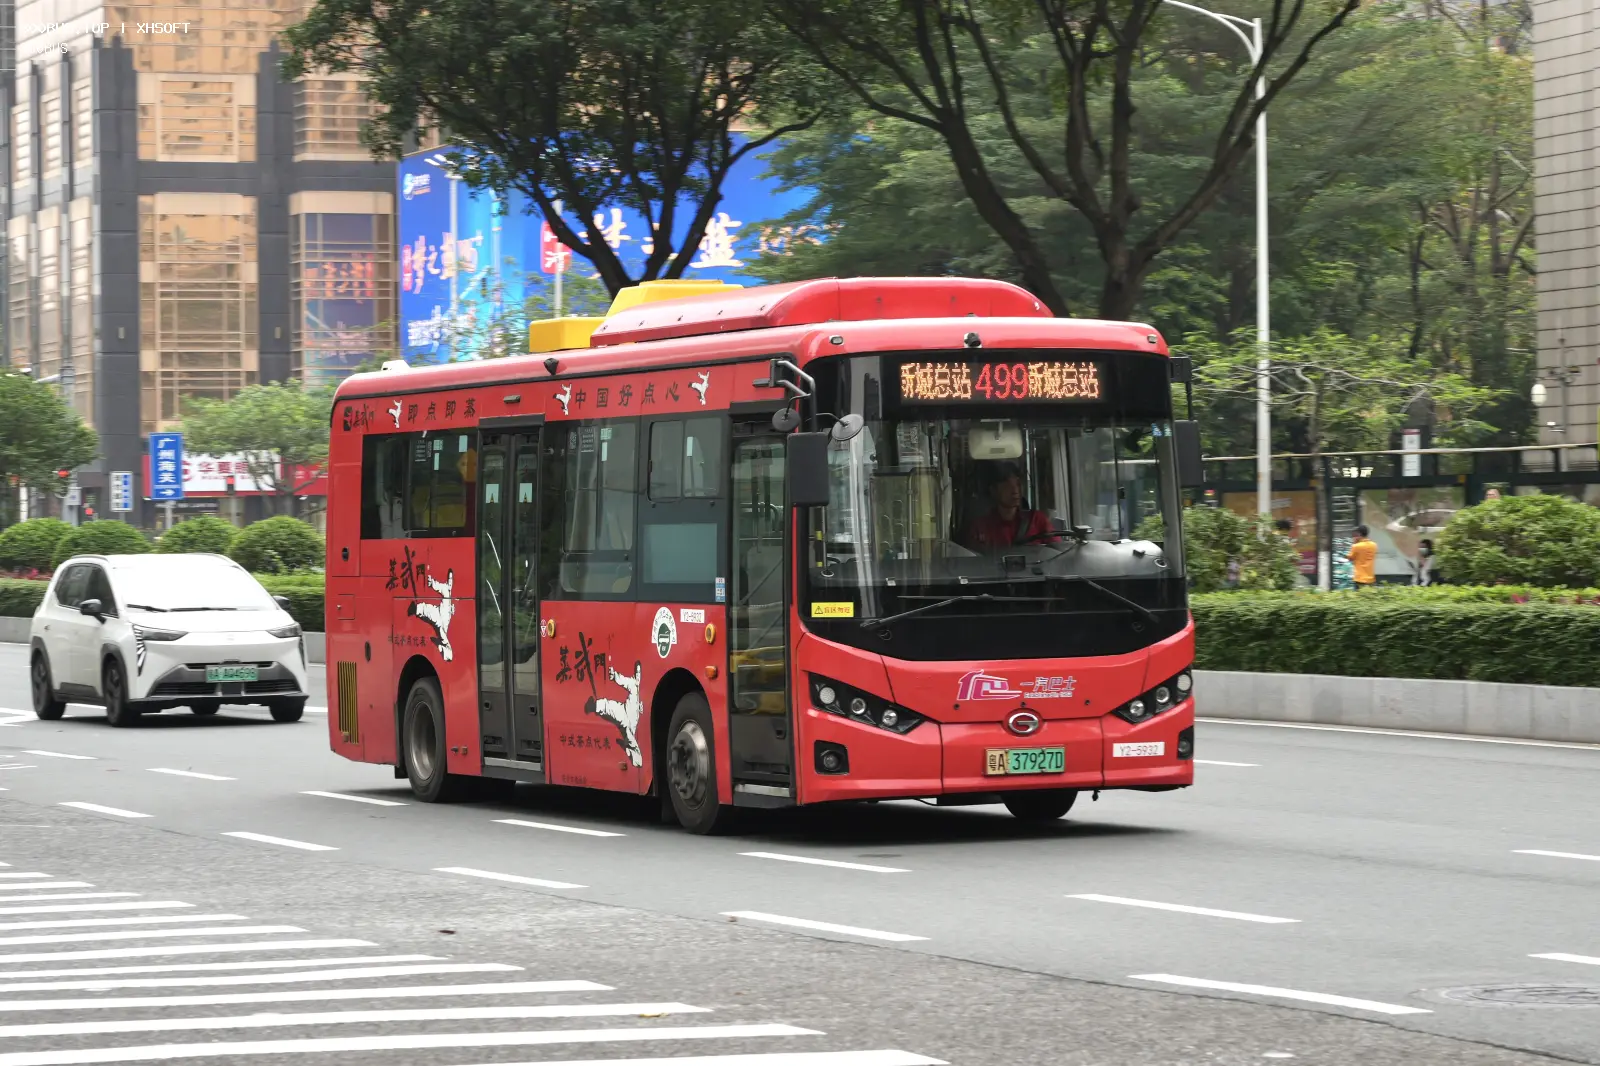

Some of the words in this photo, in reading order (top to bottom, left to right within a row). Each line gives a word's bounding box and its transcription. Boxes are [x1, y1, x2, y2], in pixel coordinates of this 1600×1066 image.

[975, 363, 1028, 399] 499
[574, 381, 680, 410] 中国好点心
[407, 397, 476, 424] 即点即蒸
[157, 437, 177, 483] 广州海关
[559, 733, 612, 750] 中式茶点代表
[1119, 744, 1159, 756] Y2-5932
